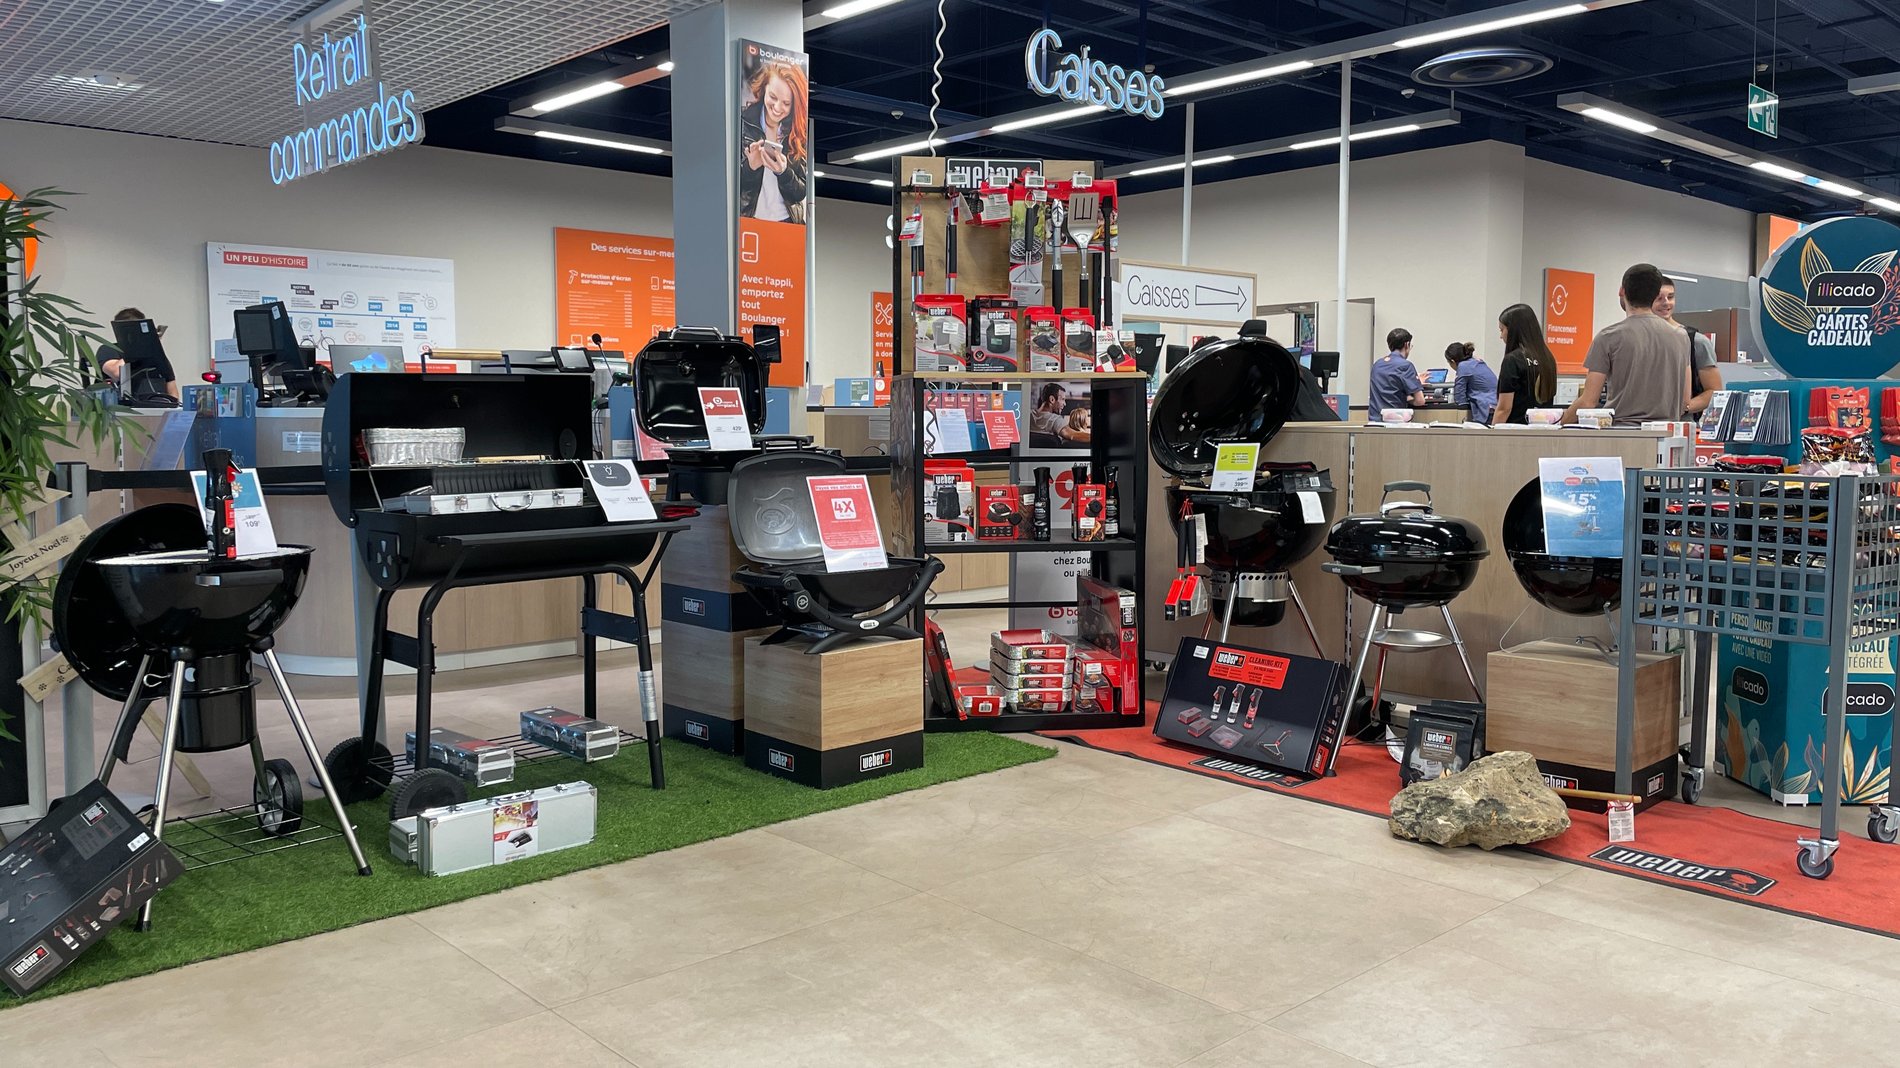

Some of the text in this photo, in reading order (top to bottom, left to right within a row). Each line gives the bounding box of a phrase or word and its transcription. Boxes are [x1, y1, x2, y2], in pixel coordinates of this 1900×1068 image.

[292, 14, 369, 106] Retrait
[759, 47, 804, 66] boulanger
[1026, 28, 1165, 119] Caisses
[269, 81, 418, 186] commandes
[591, 242, 674, 259] Des services sur-mes
[226, 253, 306, 266] UN PEU D'HISTOIRE
[741, 274, 794, 289] Avec l'appli,
[741, 288, 785, 299] emportez
[1127, 274, 1190, 309] Caisses
[1817, 282, 1876, 297] illicado
[741, 300, 761, 310] tout
[930, 307, 947, 316] weber
[741, 313, 786, 325] Boulanger
[988, 311, 1005, 319] weber
[1815, 313, 1869, 330] CARTES
[1547, 324, 1577, 334] Financement
[1547, 337, 1574, 345] sur-mesure
[1807, 330, 1874, 347] CADEAUX
[935, 474, 955, 485] weber
[834, 500, 854, 513] 4X
[8, 550, 40, 573] Joyeux
[1053, 556, 1075, 565] chez
[684, 599, 700, 613] weber
[1731, 612, 1772, 633] PERSOALISE
[1731, 642, 1744, 656] AVEC
[1756, 649, 1772, 664] VIDÉO
[1849, 639, 1885, 653] DEAU
[1218, 652, 1284, 669] weber CLEANING KIT
[1848, 653, 1884, 668] TÉGRÉE
[1846, 692, 1886, 706] cado
[687, 721, 702, 738] weber
[1427, 732, 1447, 743] weber
[770, 751, 788, 769] weber
[862, 751, 885, 770] weber
[1204, 758, 1284, 780] weber
[1544, 774, 1567, 789] eber
[1607, 849, 1727, 881] weber
[13, 952, 40, 974] weber
